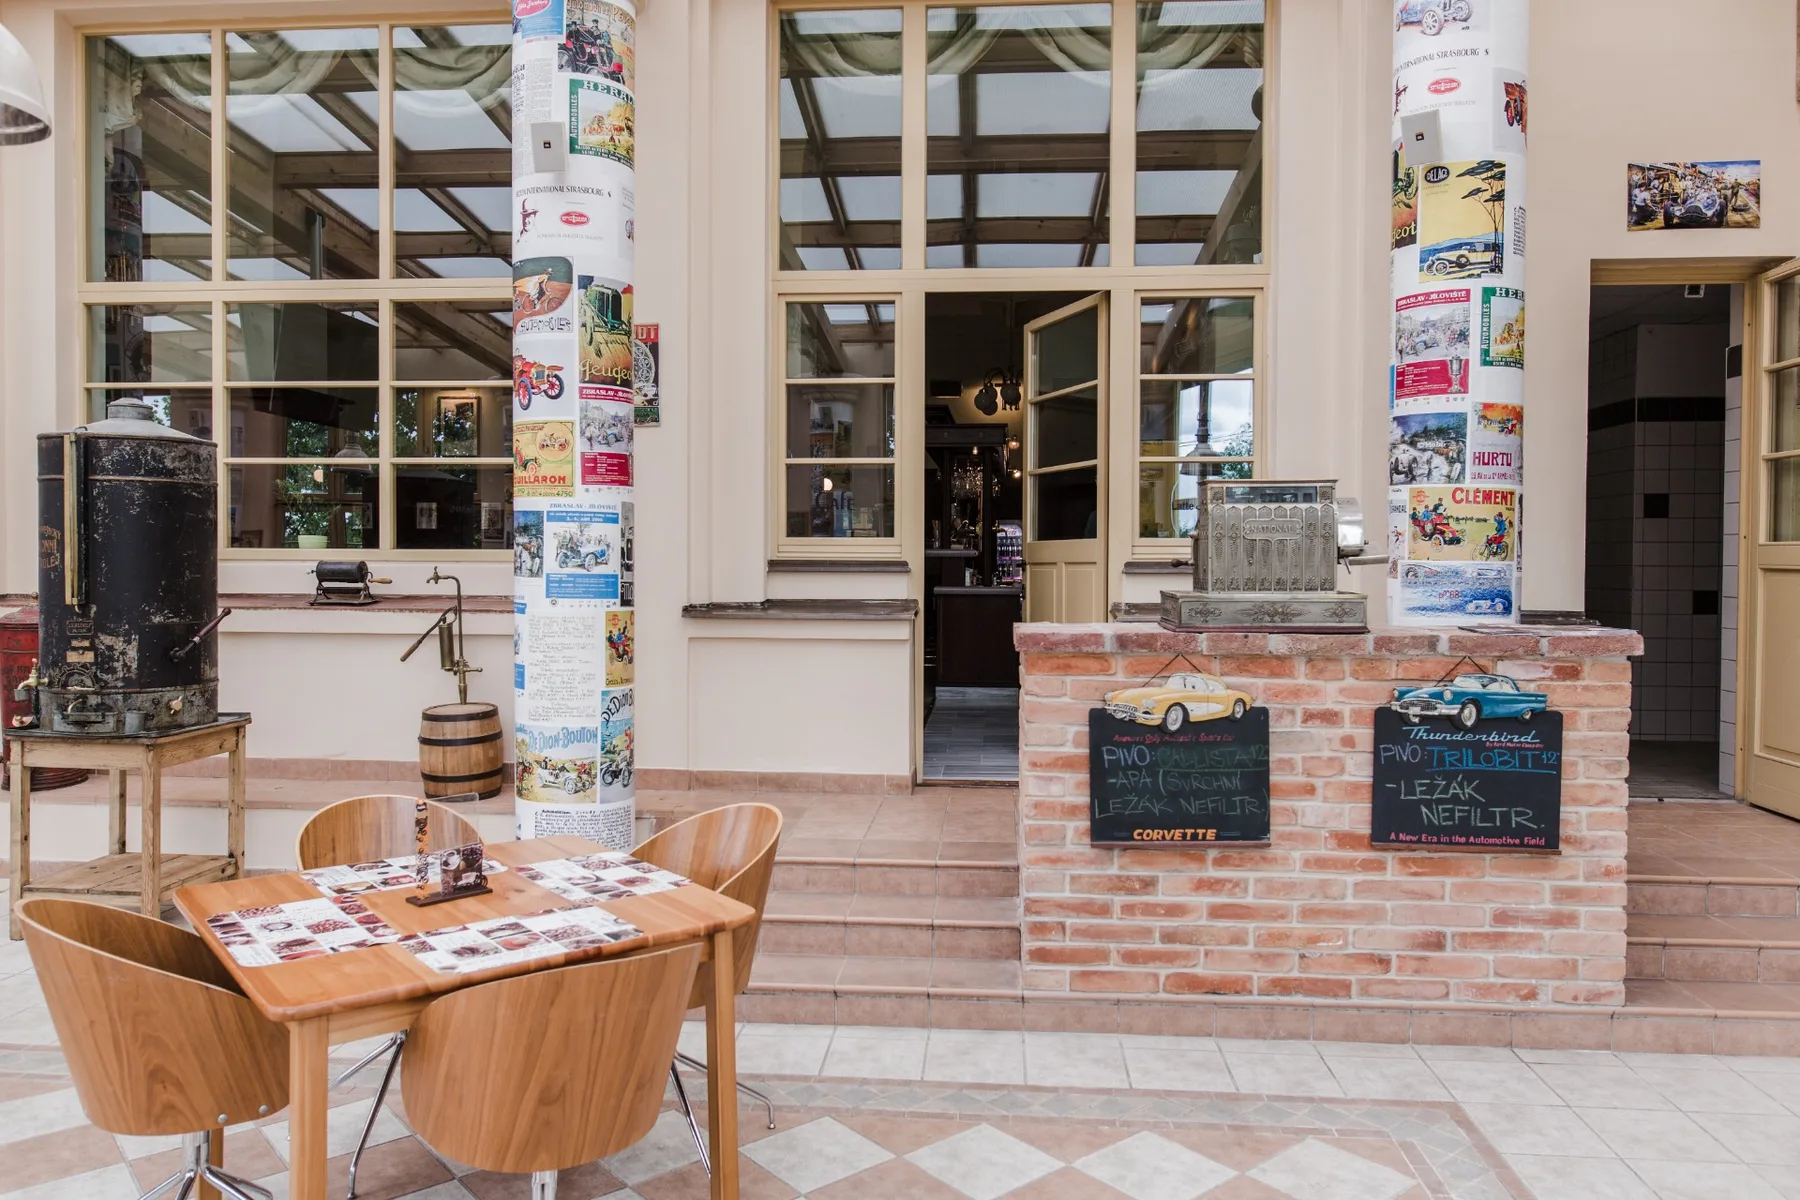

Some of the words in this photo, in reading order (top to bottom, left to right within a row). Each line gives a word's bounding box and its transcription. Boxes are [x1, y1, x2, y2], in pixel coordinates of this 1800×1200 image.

[1437, 48, 1480, 59] STRASBOURG
[570, 95, 578, 138] AUTOMOBILES
[1426, 168, 1448, 181] DELAGE
[566, 185, 604, 197] STRASBOURG
[1481, 303, 1490, 350] AUTOMOBILES
[1472, 451, 1512, 467] HURTU
[1451, 487, 1515, 506] CLÉMENT
[1172, 501, 1194, 510] Latte
[1249, 524, 1293, 533] NATIONAL
[1402, 726, 1540, 742] Thunderbird
[1427, 746, 1540, 769] TRILOBIT
[1095, 793, 1174, 819] LEŽÁK
[1133, 828, 1217, 841] CORVETTE
[1390, 832, 1396, 840] A
[1399, 832, 1419, 841] New
[1421, 833, 1437, 842] Era
[1440, 833, 1449, 843] in
[1451, 834, 1466, 843] the
[1469, 835, 1520, 845] Automotive
[1524, 836, 1545, 846] Field
